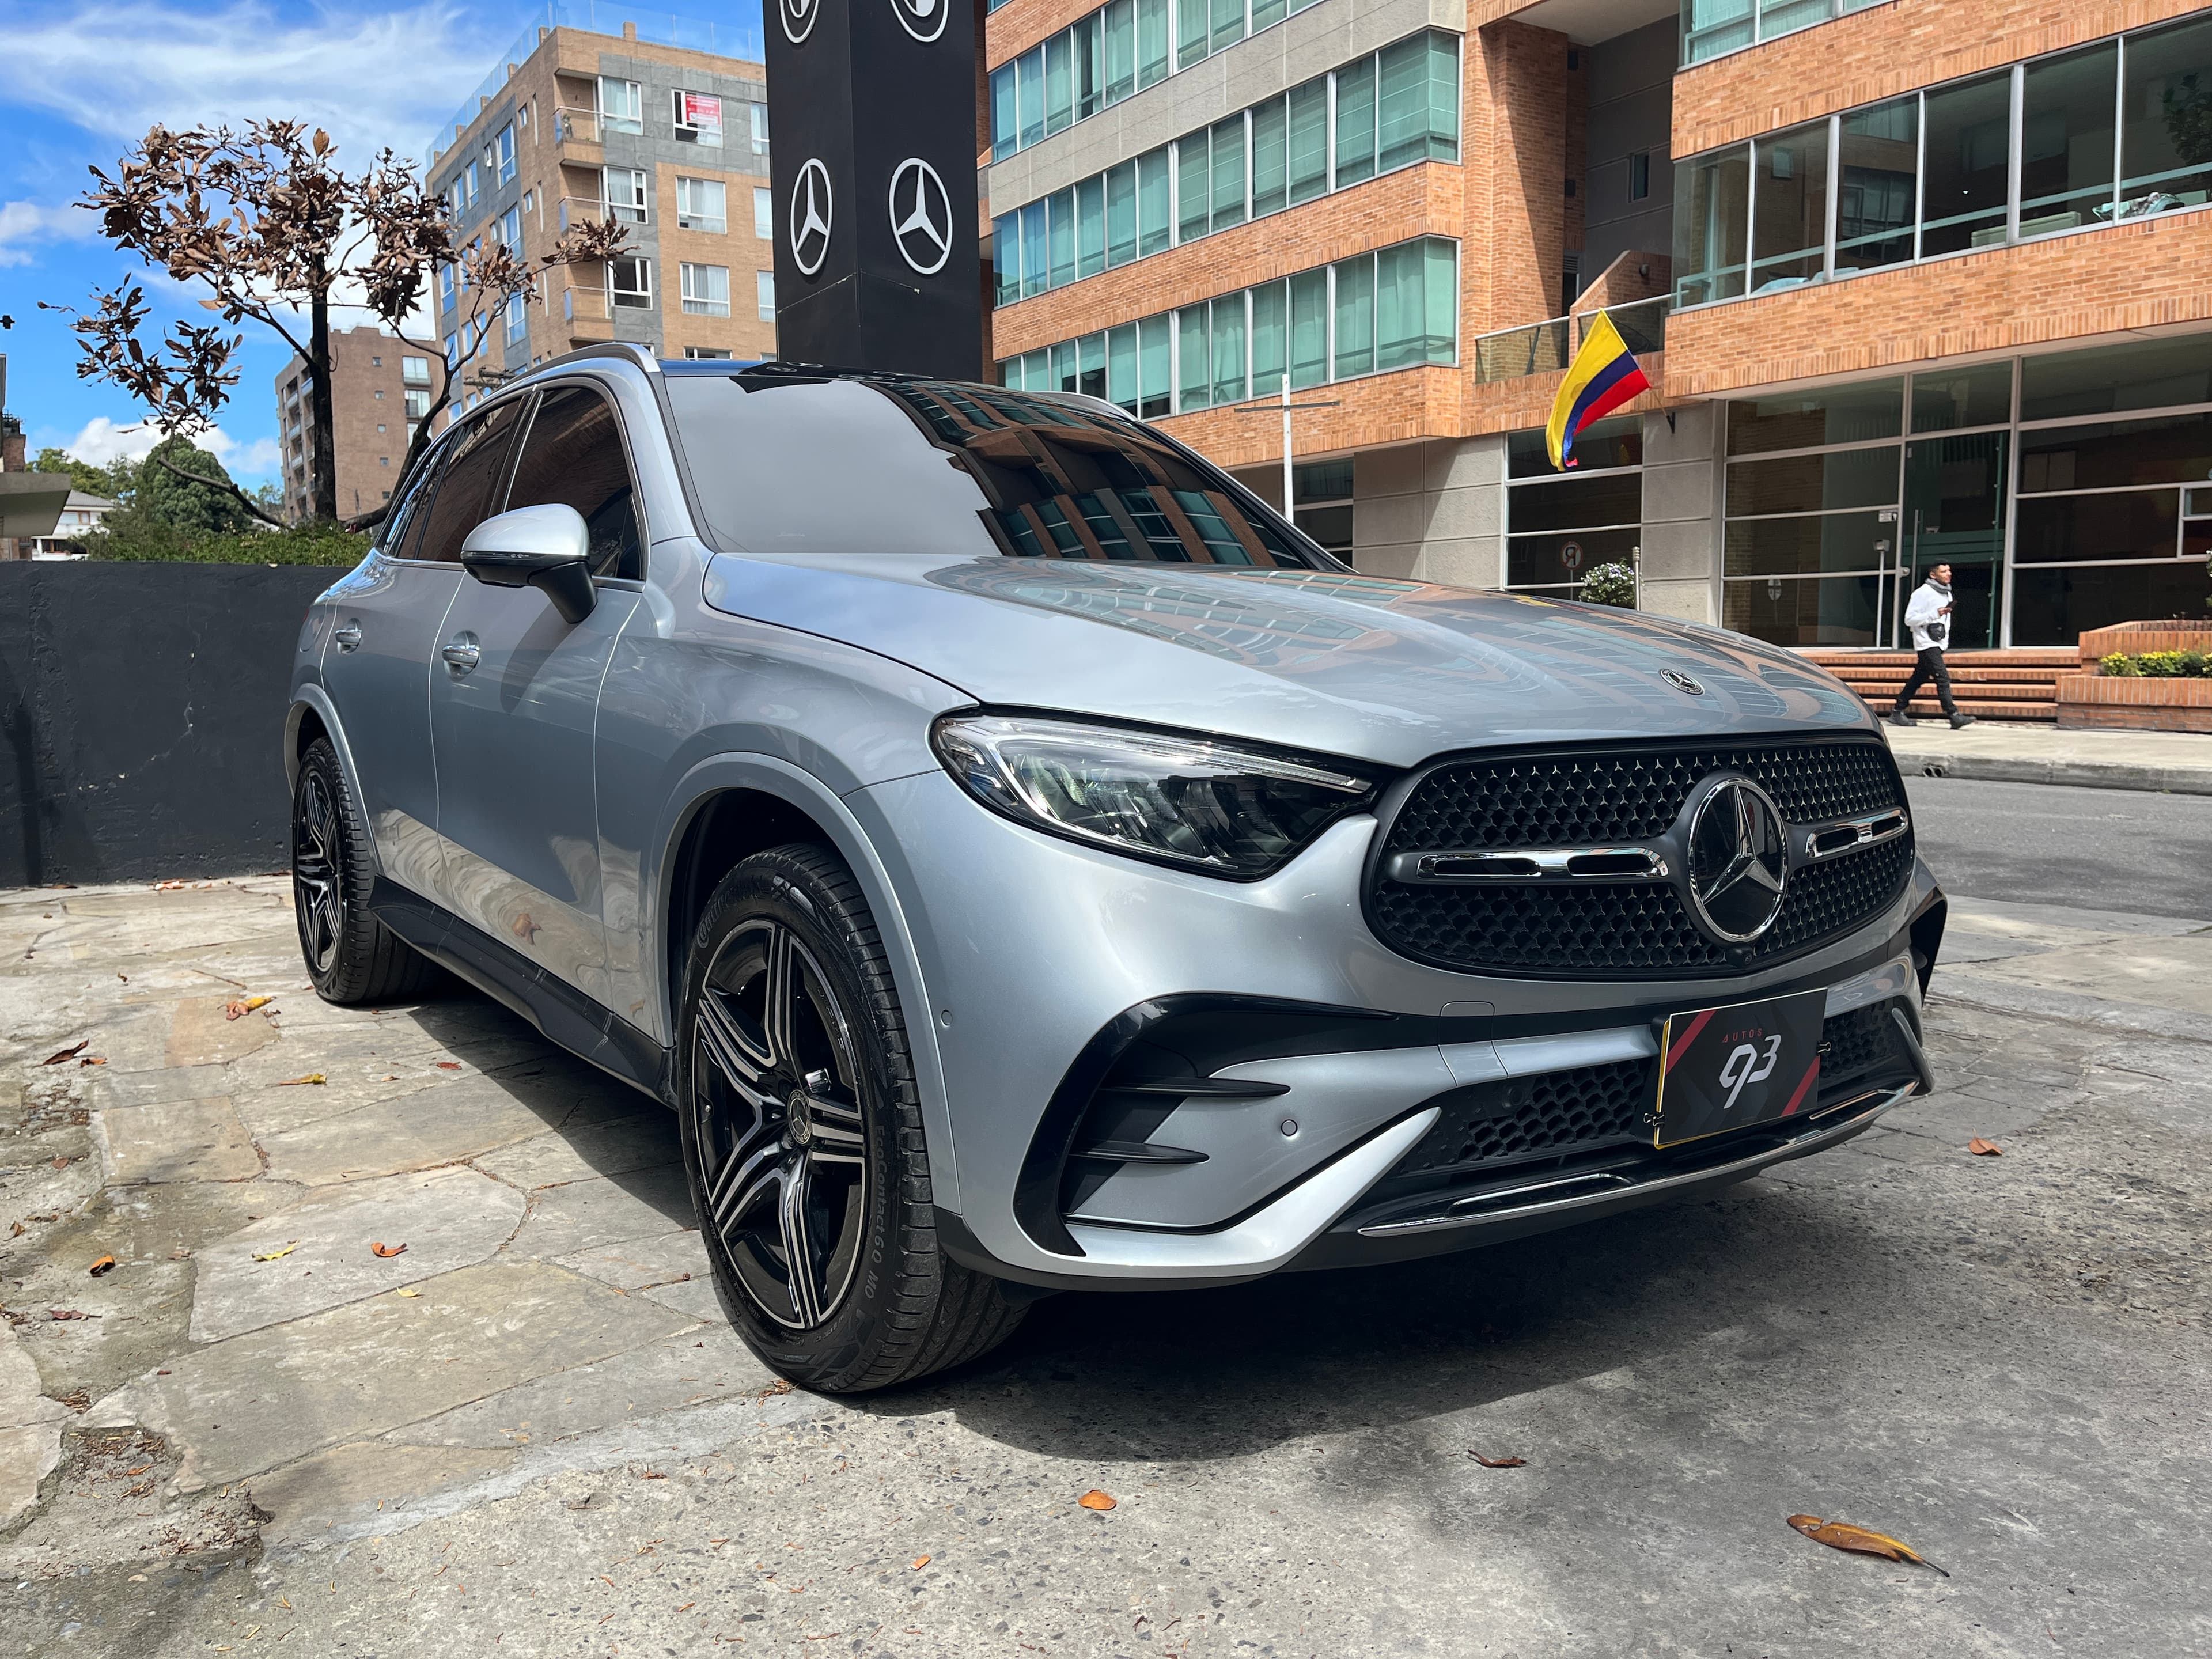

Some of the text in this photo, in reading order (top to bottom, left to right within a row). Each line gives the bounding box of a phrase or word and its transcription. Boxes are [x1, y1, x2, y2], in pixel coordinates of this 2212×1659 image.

[1722, 1028, 1763, 1043] AUTOS
[1719, 1033, 1782, 1109] 93
[875, 1124, 888, 1233] EcoContact
[865, 1270, 879, 1299] MO
